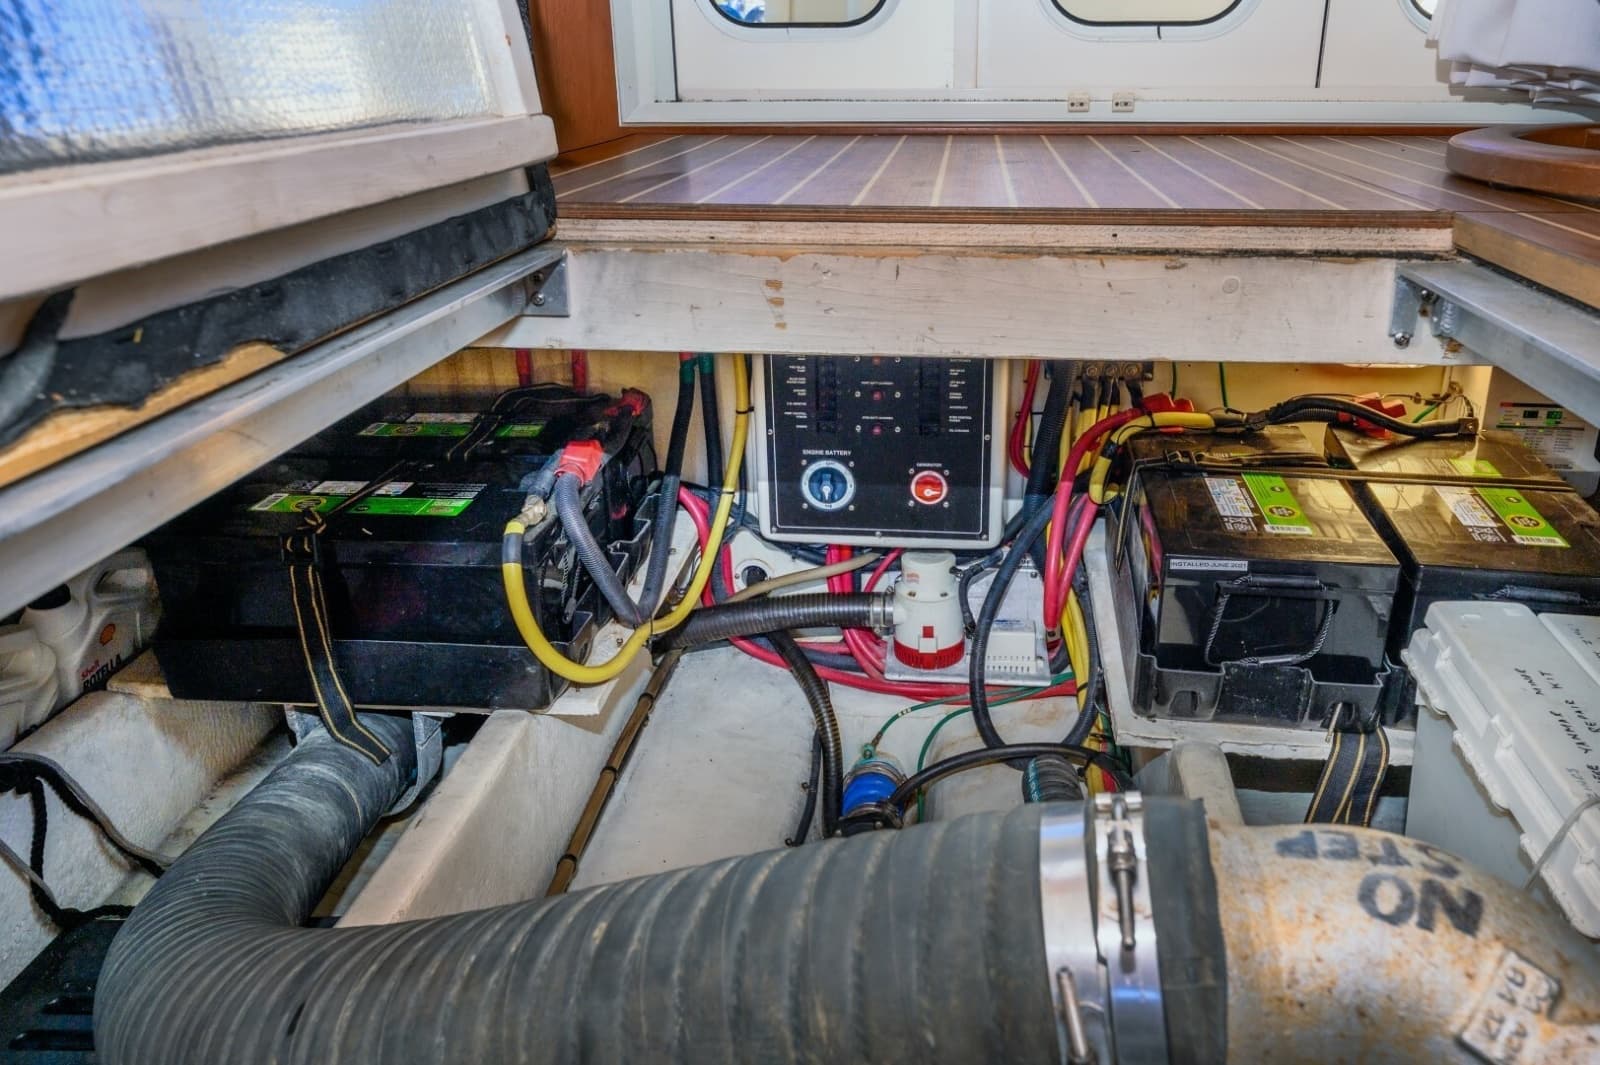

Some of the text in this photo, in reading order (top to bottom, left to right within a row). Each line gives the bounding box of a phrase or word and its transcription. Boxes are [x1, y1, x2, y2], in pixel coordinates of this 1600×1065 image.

[825, 449, 852, 457] BATTERY
[1172, 560, 1209, 568] INSTALLED
[83, 653, 122, 692] ROTELLA
[1537, 669, 1564, 689] KIT
[1548, 710, 1593, 754] YANMAR
[1275, 829, 1462, 880] STEP
[1357, 872, 1485, 938] NO
